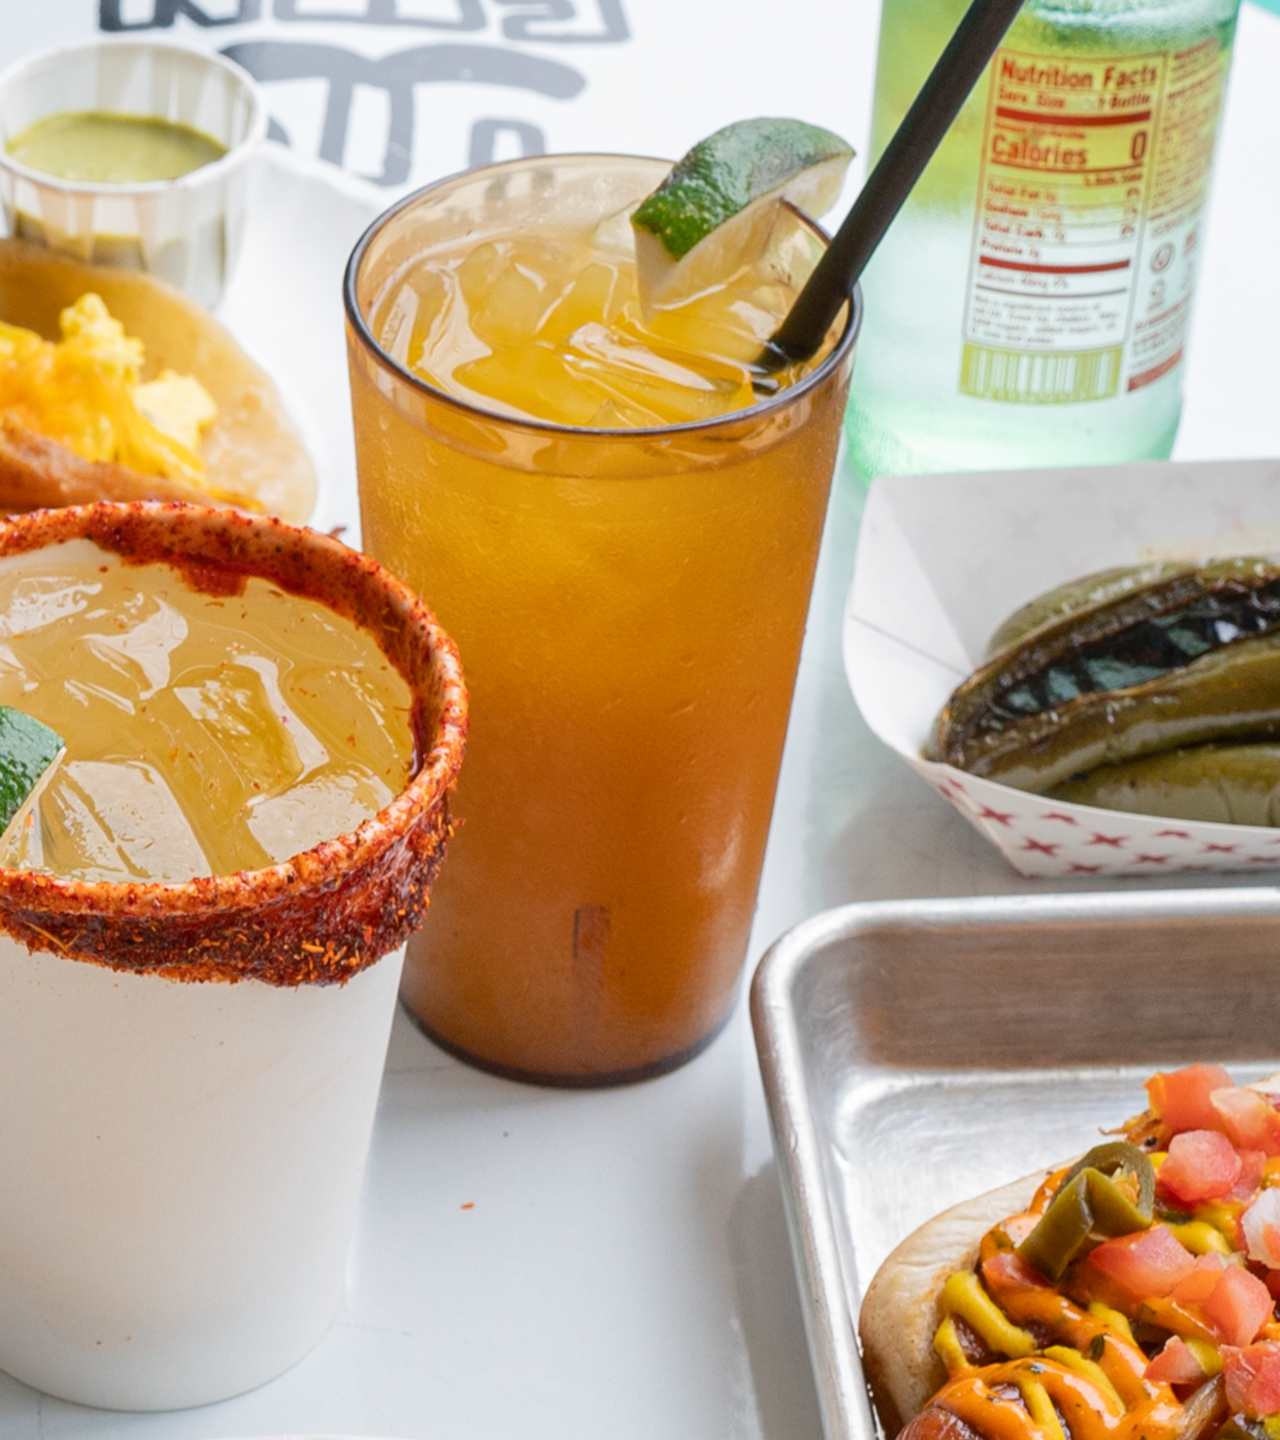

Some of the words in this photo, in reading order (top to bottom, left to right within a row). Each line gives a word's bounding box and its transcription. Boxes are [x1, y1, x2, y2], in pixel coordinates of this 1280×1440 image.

[1002, 59, 1094, 88] Nutrition
[1103, 65, 1157, 89] Facts
[991, 133, 1088, 166] Calories
[1130, 130, 1148, 161] 0
